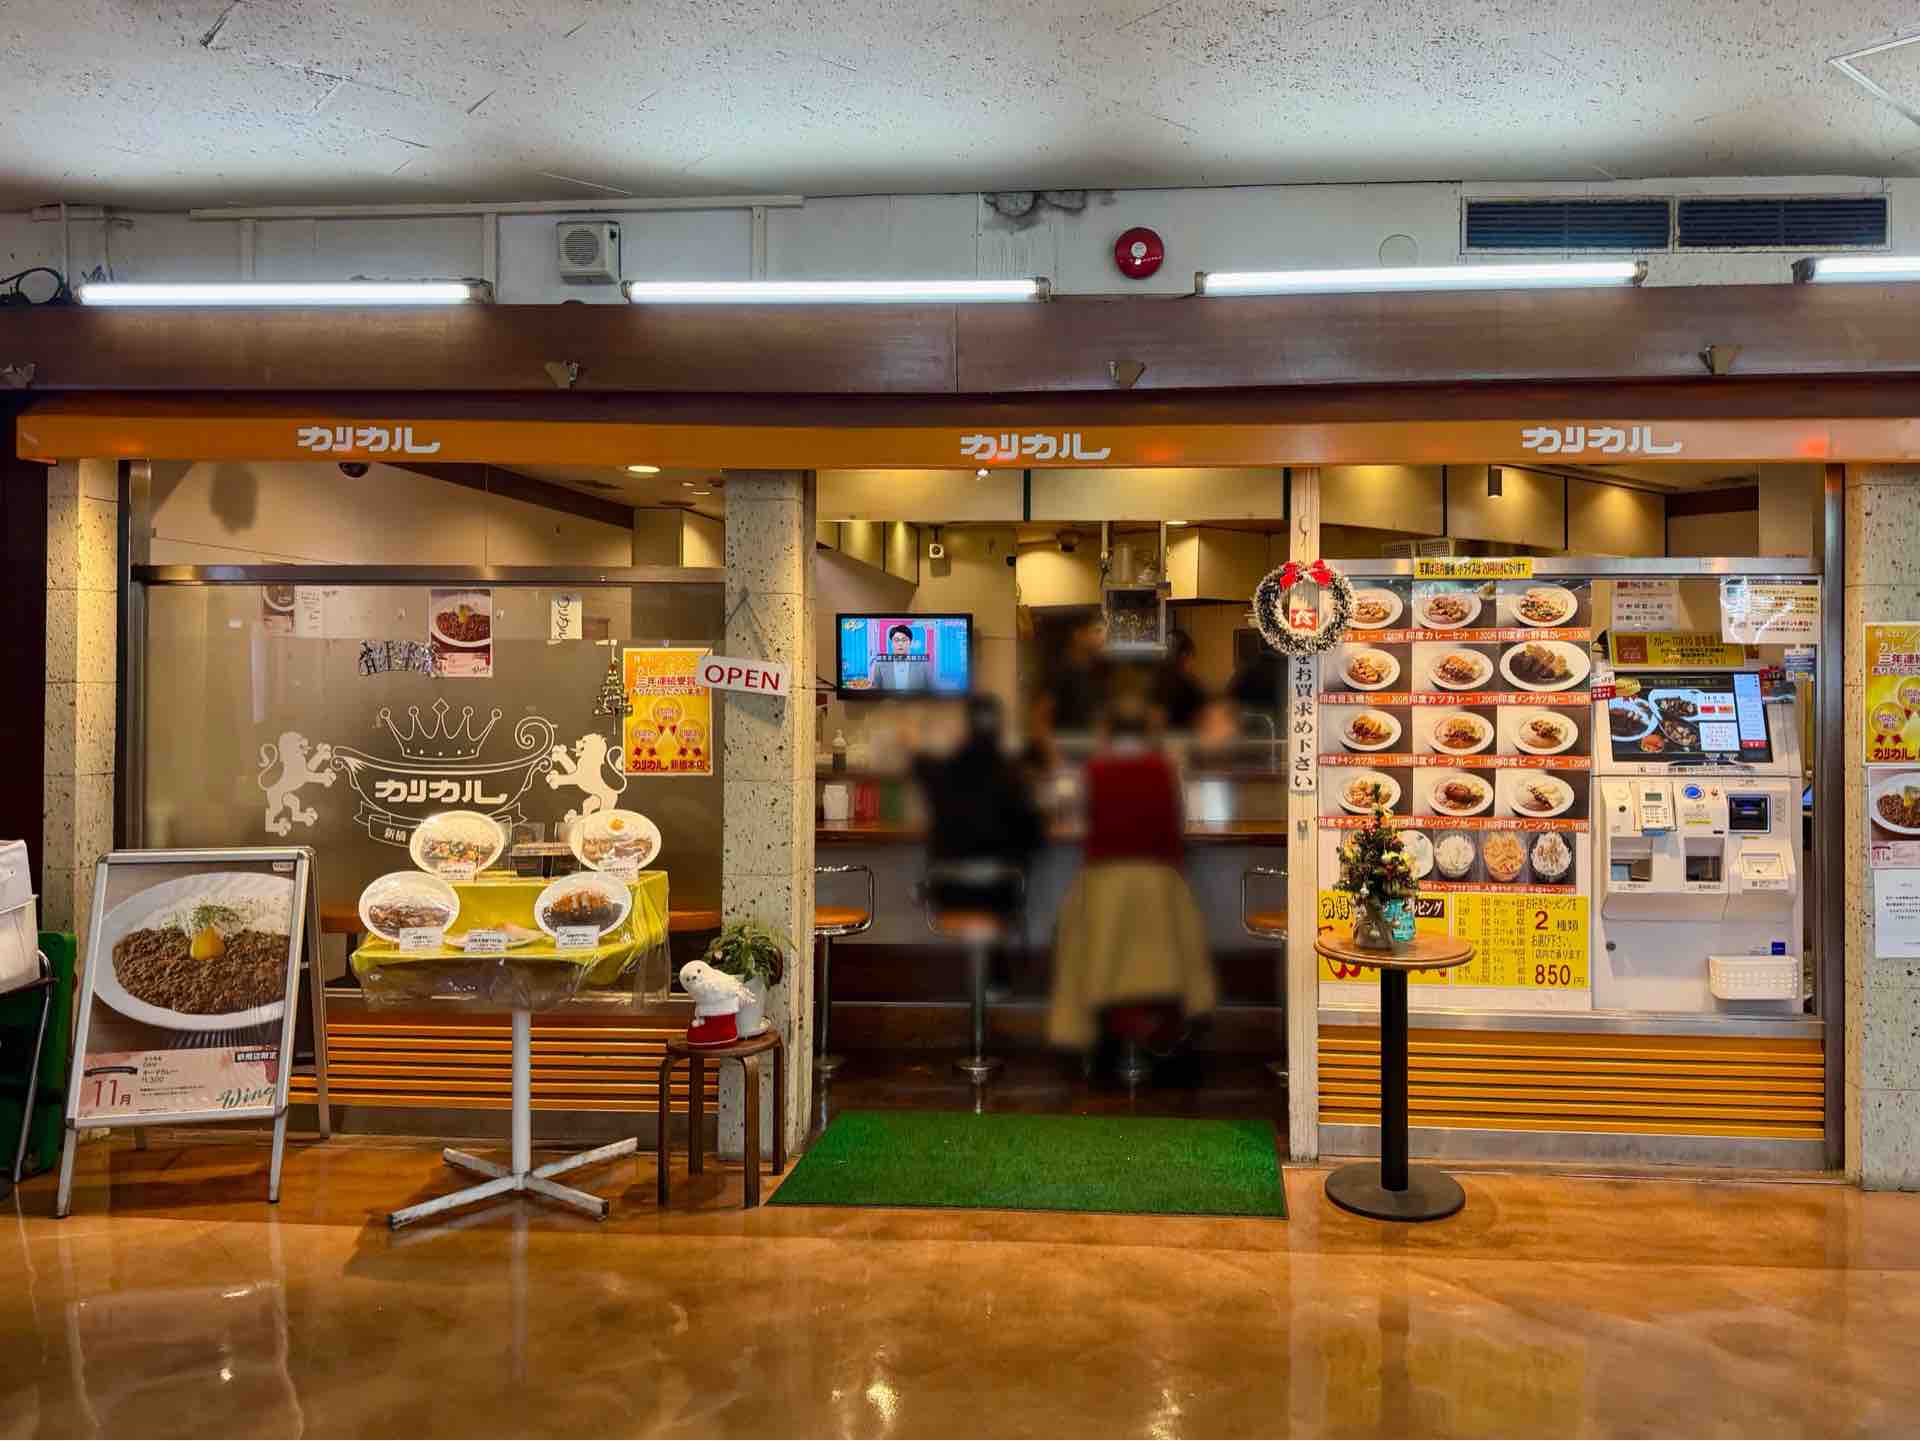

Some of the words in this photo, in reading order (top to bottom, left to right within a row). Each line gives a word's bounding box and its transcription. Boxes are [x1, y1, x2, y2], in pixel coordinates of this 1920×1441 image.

[297, 426, 441, 454] カリカル
[960, 432, 1112, 460] カリカル
[1521, 426, 1683, 454] カリカル
[704, 664, 780, 691] OPEN
[375, 779, 508, 804] カリカル
[1535, 911, 1549, 930] 2
[95, 1079, 132, 1107] 11月
